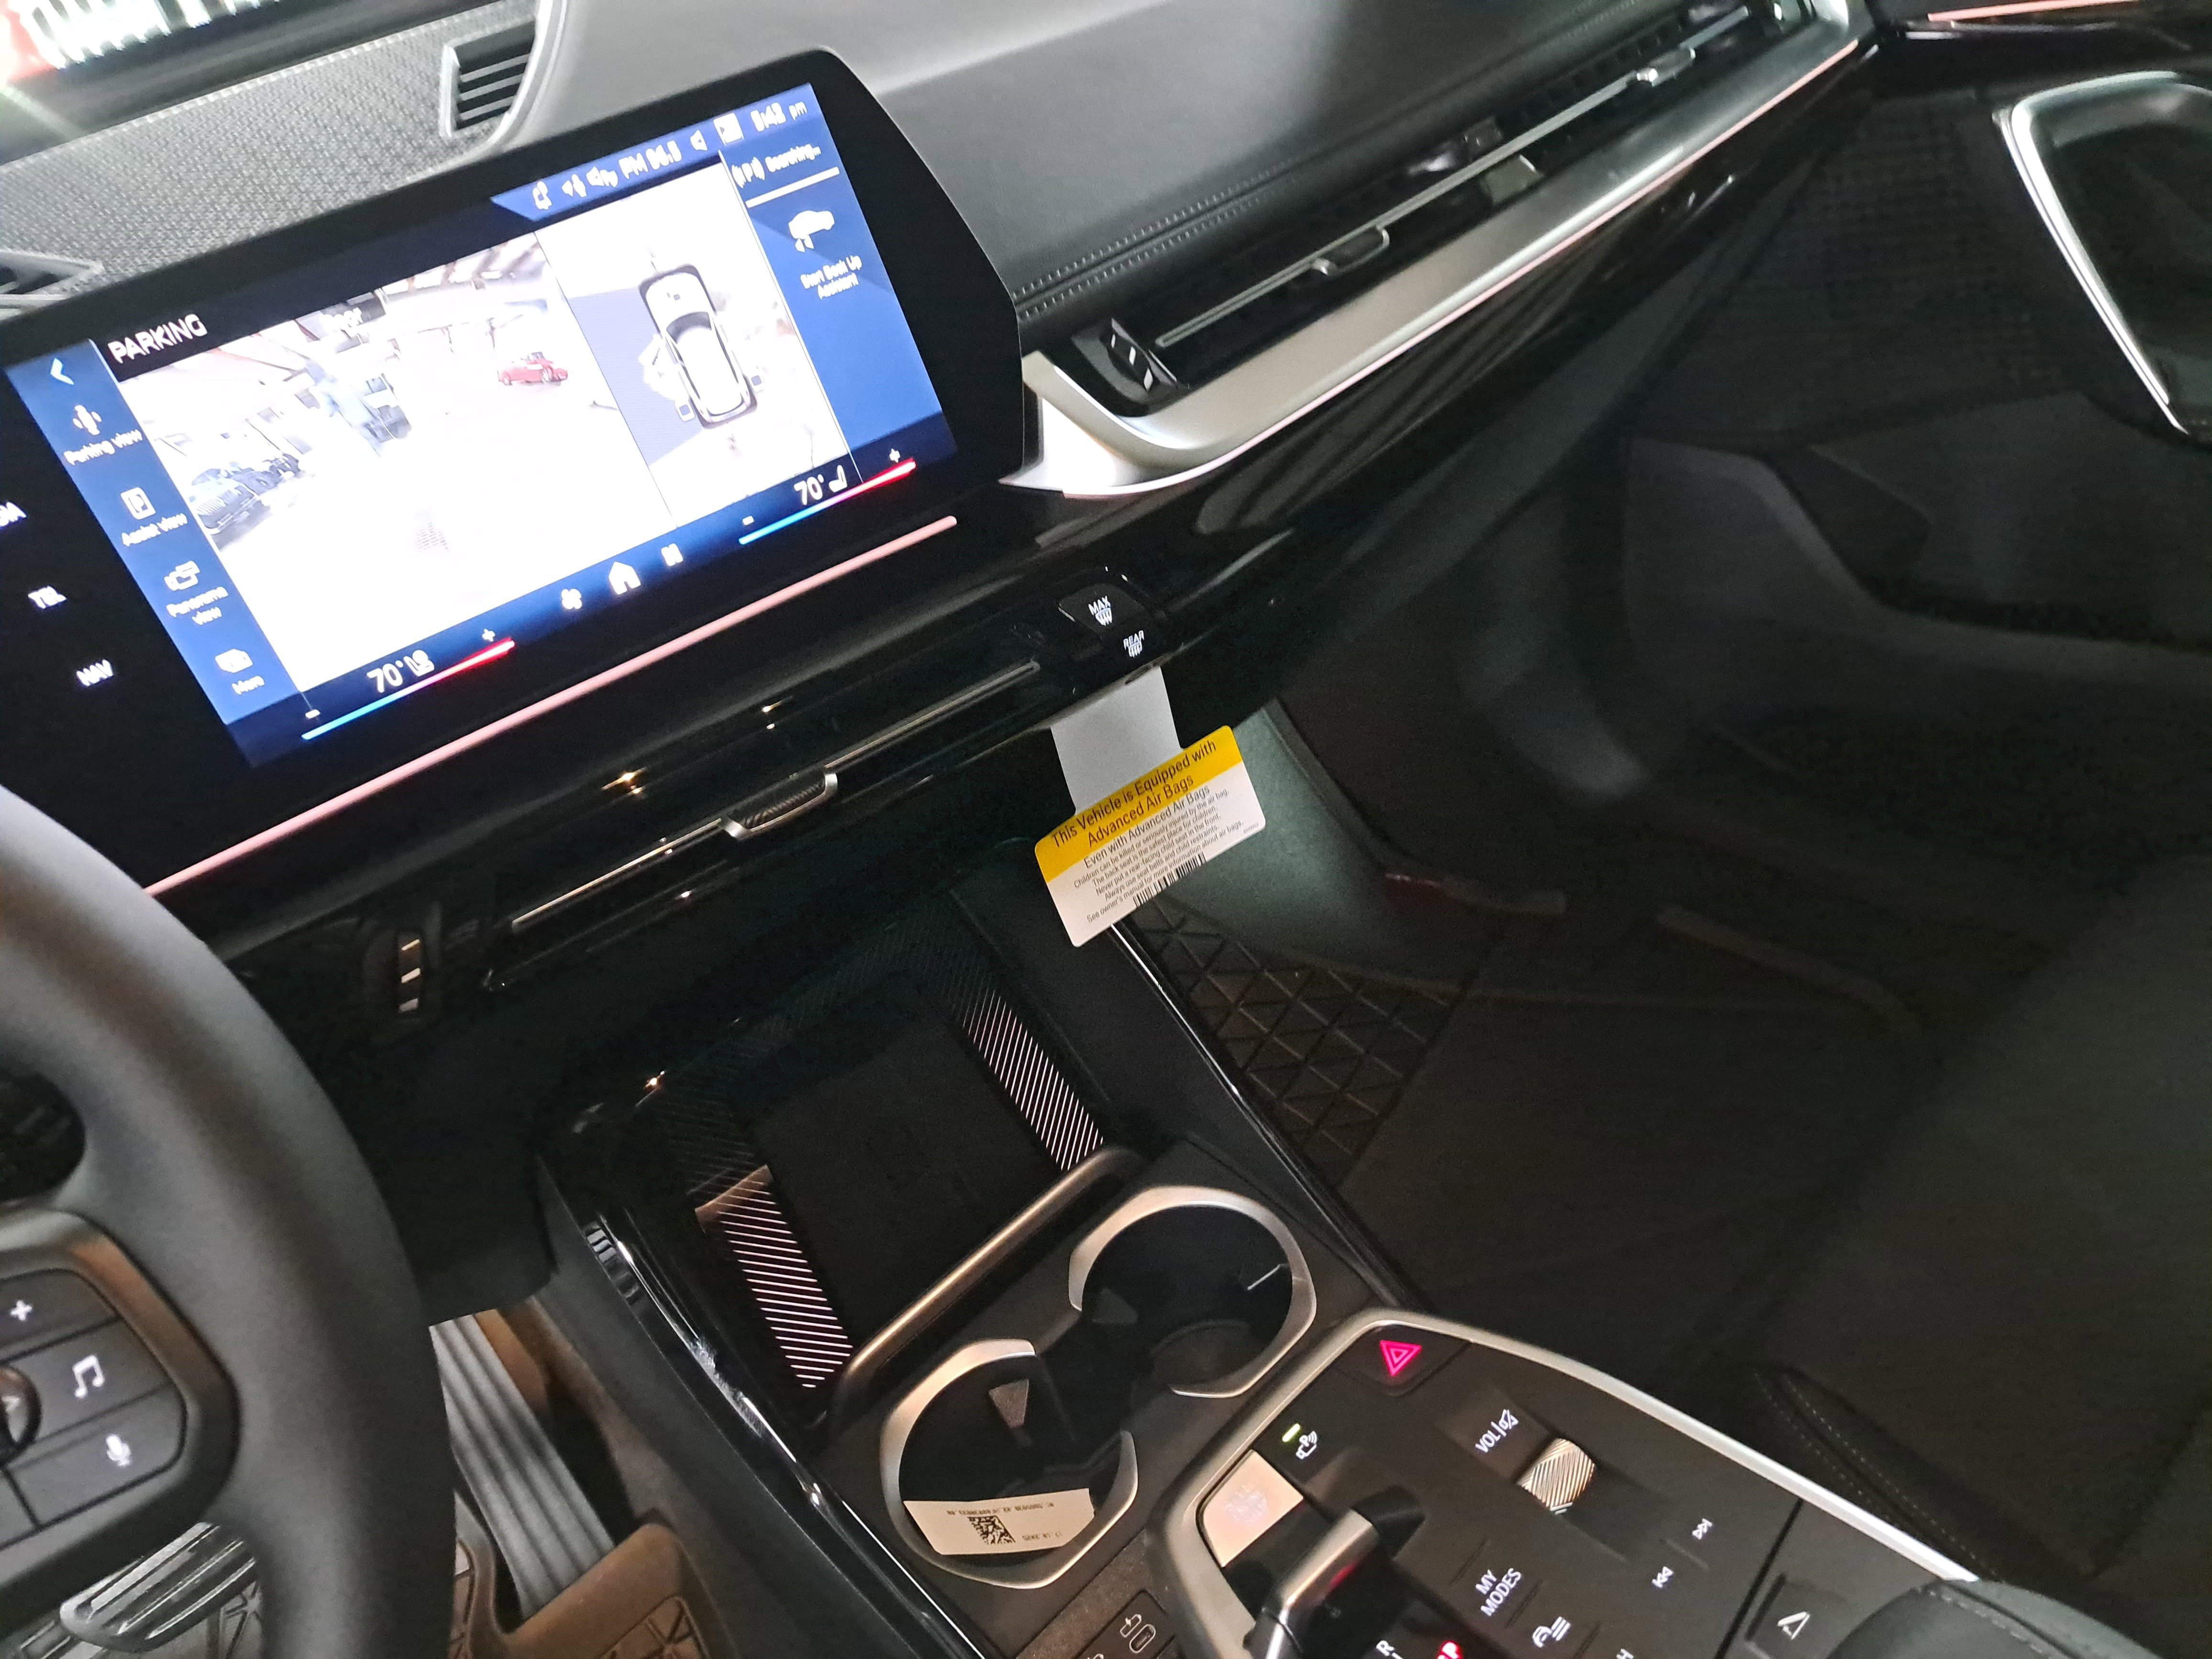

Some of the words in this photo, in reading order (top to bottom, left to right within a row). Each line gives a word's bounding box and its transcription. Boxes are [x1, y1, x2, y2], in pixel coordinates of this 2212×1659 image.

[108, 313, 208, 364] PARKING
[64, 441, 115, 465] Parking
[111, 429, 143, 448] view
[157, 513, 188, 531] view
[166, 586, 229, 618] Panorama
[192, 607, 222, 625] view
[1088, 595, 1111, 616] MAX
[76, 659, 114, 686] NAV
[232, 675, 265, 695] More
[1052, 825, 1077, 848] This
[1076, 797, 1121, 830] Vehicle
[1134, 753, 1190, 796] Equipped
[1192, 740, 1217, 762] with
[1088, 801, 1144, 848] Advanced
[1146, 793, 1161, 811] Air
[1163, 775, 1194, 799] Bags
[1074, 869, 1099, 889] Children
[1100, 862, 1111, 872] can
[1110, 854, 1119, 863] be
[1118, 844, 1135, 859] killed
[1142, 824, 1168, 844] seriously
[1169, 811, 1188, 828] injured
[1188, 807, 1196, 818] by
[1197, 801, 1207, 810] the
[1084, 850, 1107, 869] Even
[1108, 835, 1128, 853] with
[1128, 806, 1172, 841] Advanced
[1172, 798, 1185, 813] Air
[1186, 785, 1210, 805] Bags
[1092, 875, 1105, 886] The
[1105, 865, 1119, 878] back
[1120, 855, 1132, 869] seat
[1139, 846, 1148, 855] the
[1149, 835, 1166, 850] safest
[1167, 827, 1183, 842] place
[1183, 819, 1192, 829] for
[1095, 881, 1114, 896] Never
[1114, 874, 1124, 887] put
[1161, 840, 1175, 854] child
[1175, 833, 1188, 844] seat
[1188, 827, 1194, 836] in
[1194, 822, 1205, 832] the
[1105, 884, 1125, 901] Always
[1125, 876, 1136, 886] use
[1137, 868, 1149, 879] seat
[1149, 857, 1164, 871] belts
[1164, 851, 1175, 861] and
[1176, 839, 1190, 855] child
[1087, 911, 1100, 923] See
[1100, 896, 1123, 916] owner's
[1124, 881, 1144, 900] manual
[1144, 876, 1152, 886] for
[1153, 866, 1168, 879] more
[1169, 845, 1201, 870] information
[1202, 834, 1218, 849] about
[1475, 1430, 1501, 1453] VOL
[1475, 1569, 1497, 1595] MY
[1481, 1568, 1522, 1616] MODES
[1376, 1640, 1395, 1657] R
